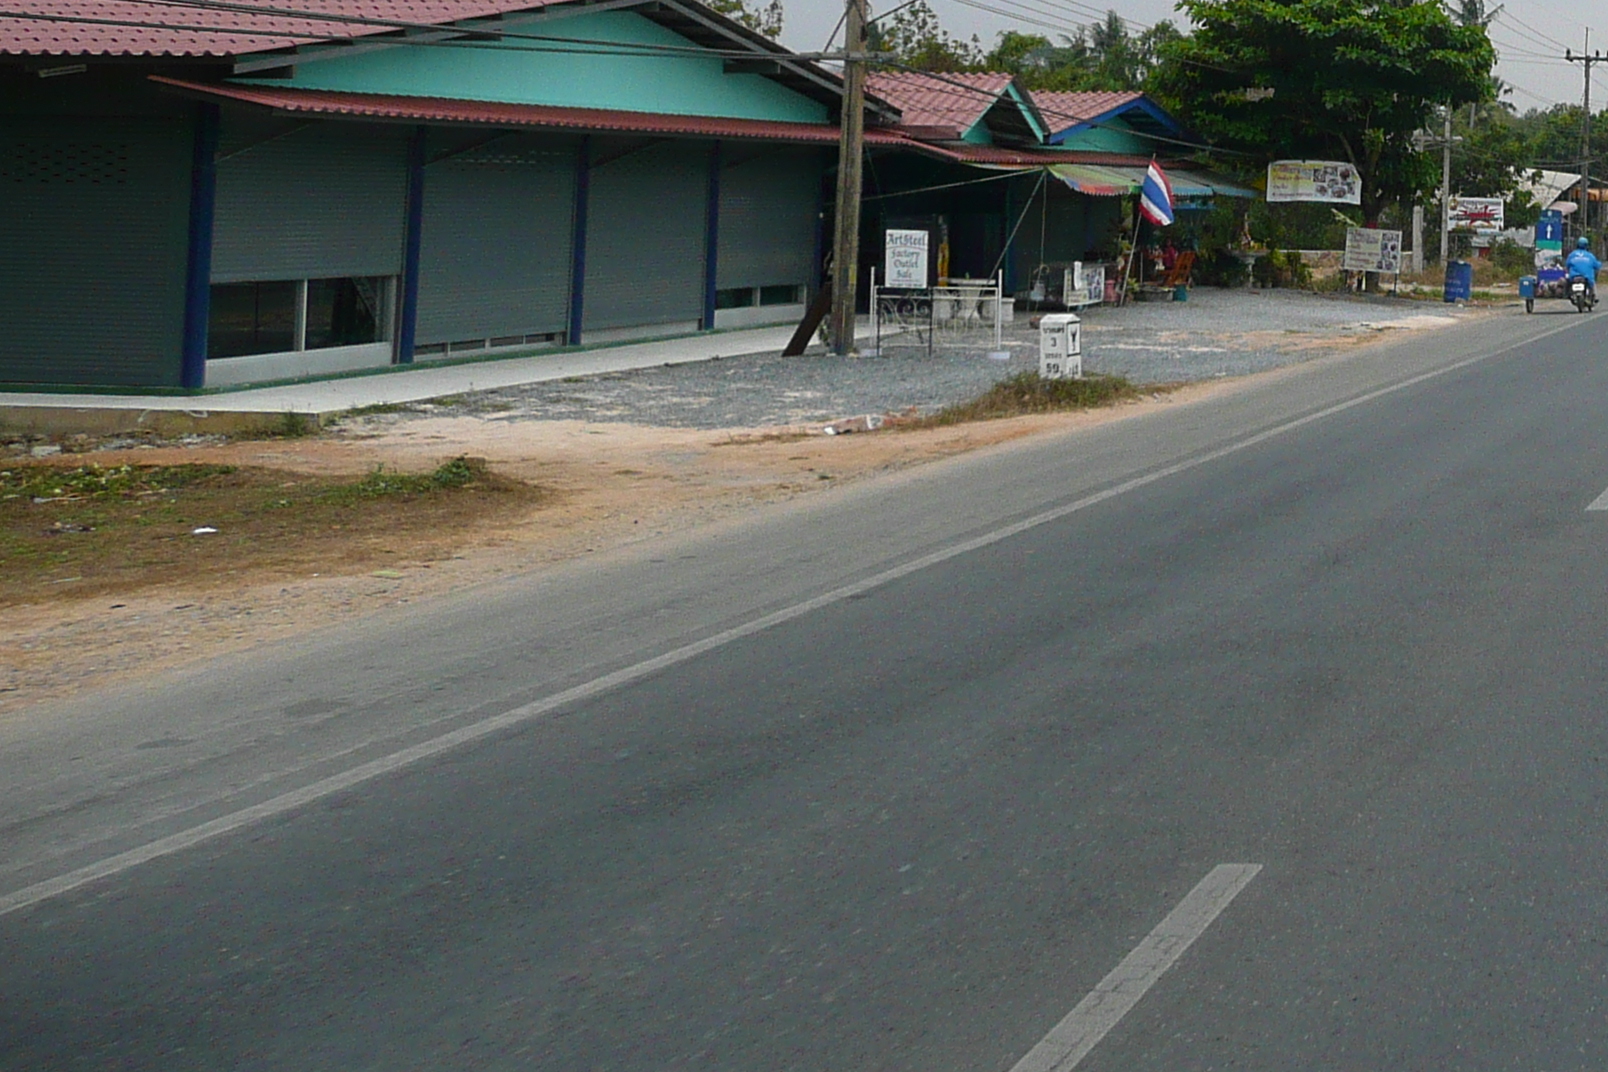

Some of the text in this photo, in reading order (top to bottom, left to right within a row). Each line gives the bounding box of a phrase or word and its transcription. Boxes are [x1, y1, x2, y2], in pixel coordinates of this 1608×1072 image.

[891, 249, 921, 259] Factory
[893, 259, 919, 268] Outlet
[896, 269, 912, 279] Sale
